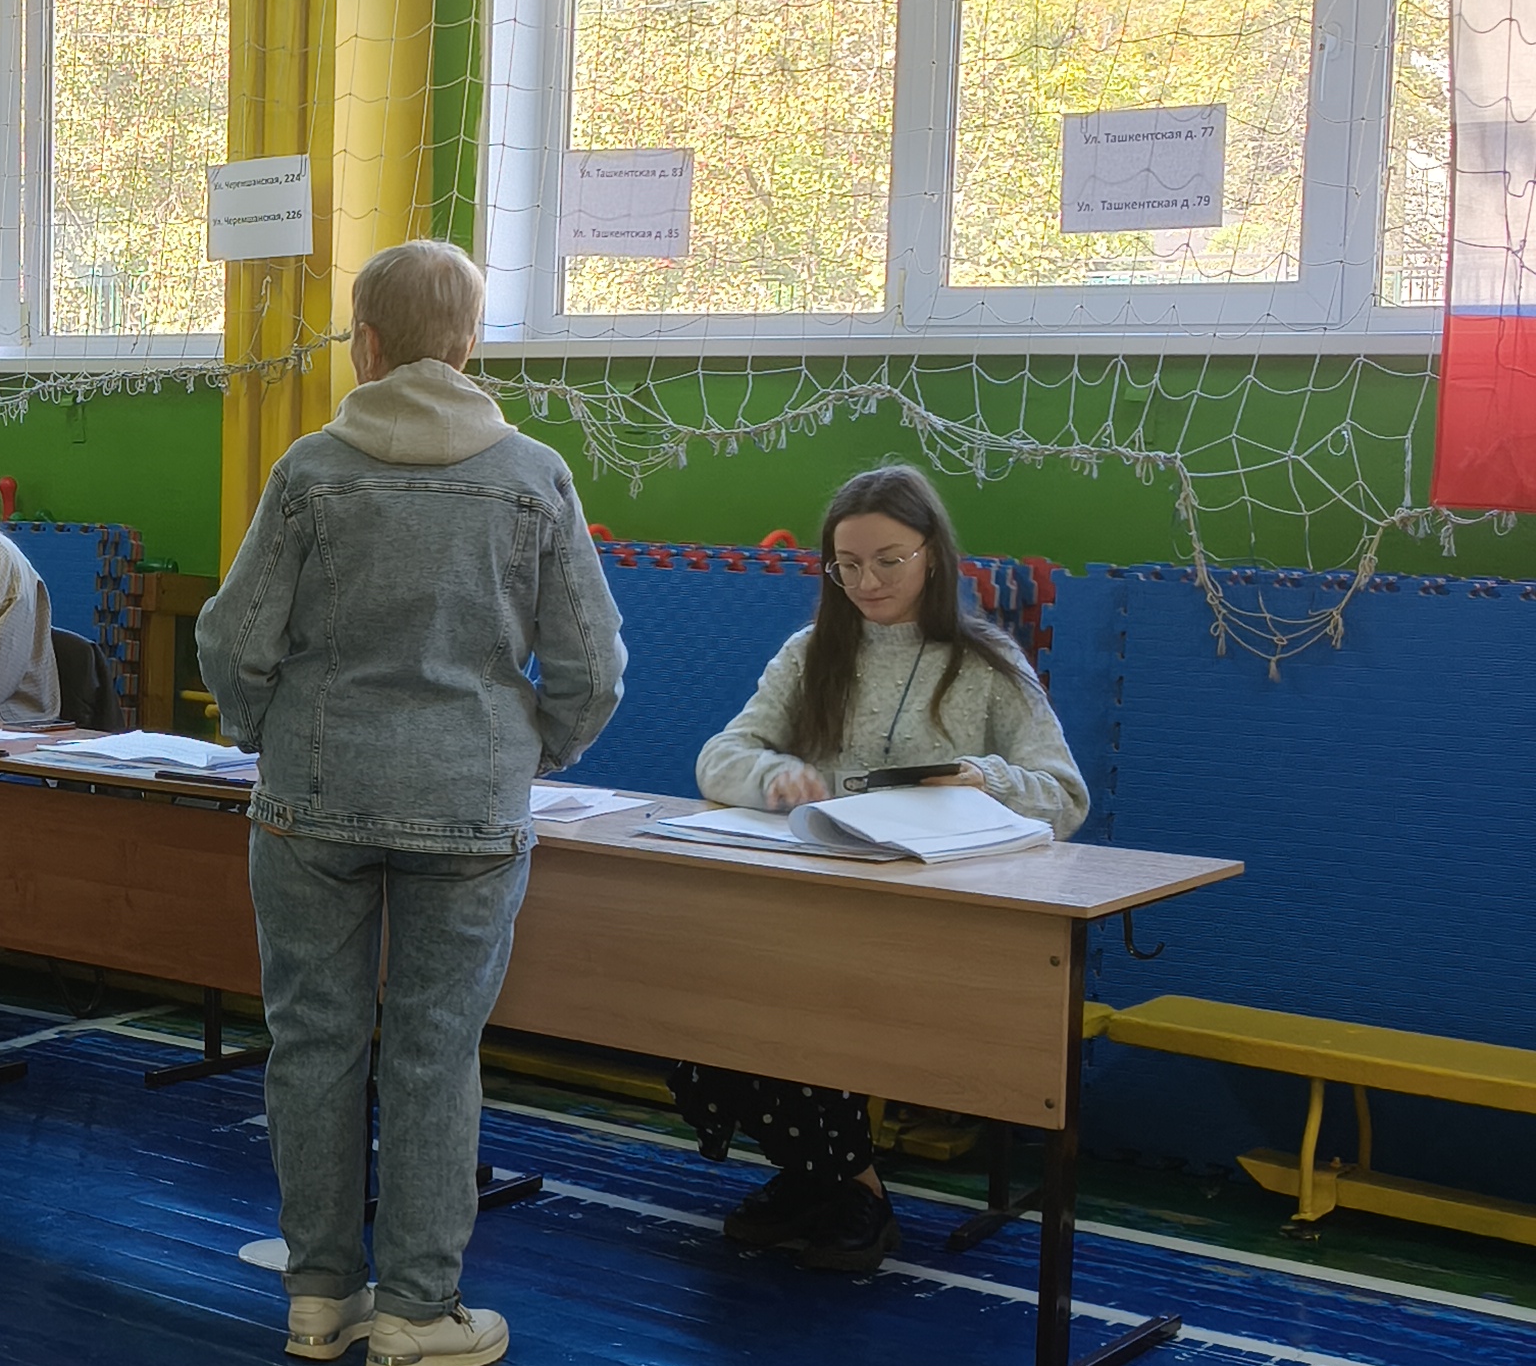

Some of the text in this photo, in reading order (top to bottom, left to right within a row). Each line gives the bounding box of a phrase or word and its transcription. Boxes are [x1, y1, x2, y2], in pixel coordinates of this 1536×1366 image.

[1104, 129, 1182, 144] Ташкентская
[1200, 126, 1215, 138] 77
[1100, 197, 1178, 211] Ташкентская
[285, 209, 303, 220] 226
